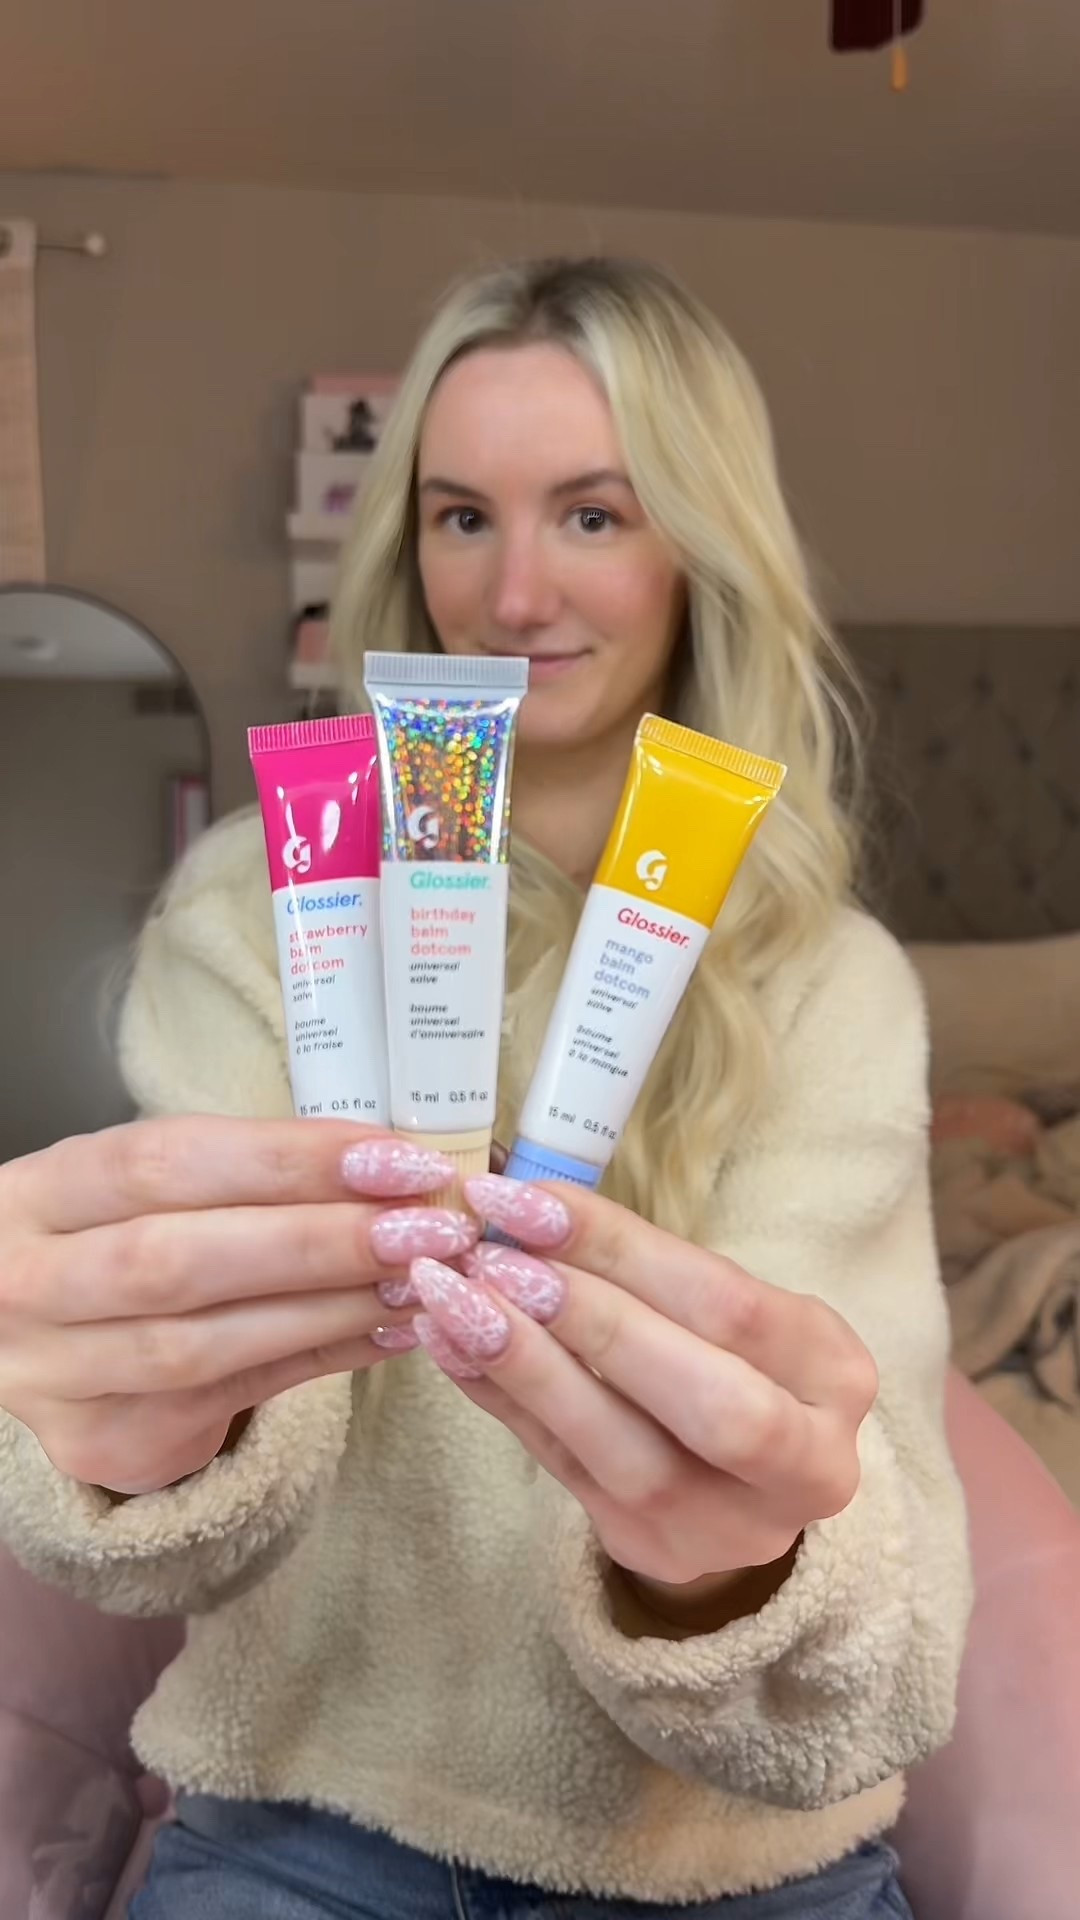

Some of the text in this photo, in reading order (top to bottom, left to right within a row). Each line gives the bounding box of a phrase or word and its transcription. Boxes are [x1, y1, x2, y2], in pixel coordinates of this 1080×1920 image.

[411, 907, 476, 924] birthday
[411, 925, 449, 938] balm
[617, 907, 691, 949] Glossier.
[411, 943, 472, 956] dotcom
[605, 938, 654, 966] mango
[410, 961, 460, 971] universal
[600, 952, 636, 975] balm
[410, 974, 438, 984] salve
[594, 969, 651, 999] dotcom
[410, 1003, 448, 1014] baume
[295, 1017, 326, 1030] baume
[410, 1016, 460, 1027] universel
[411, 1091, 421, 1102] 15
[425, 1092, 439, 1103] ml
[300, 1105, 308, 1116] 15
[310, 1102, 322, 1114] ml
